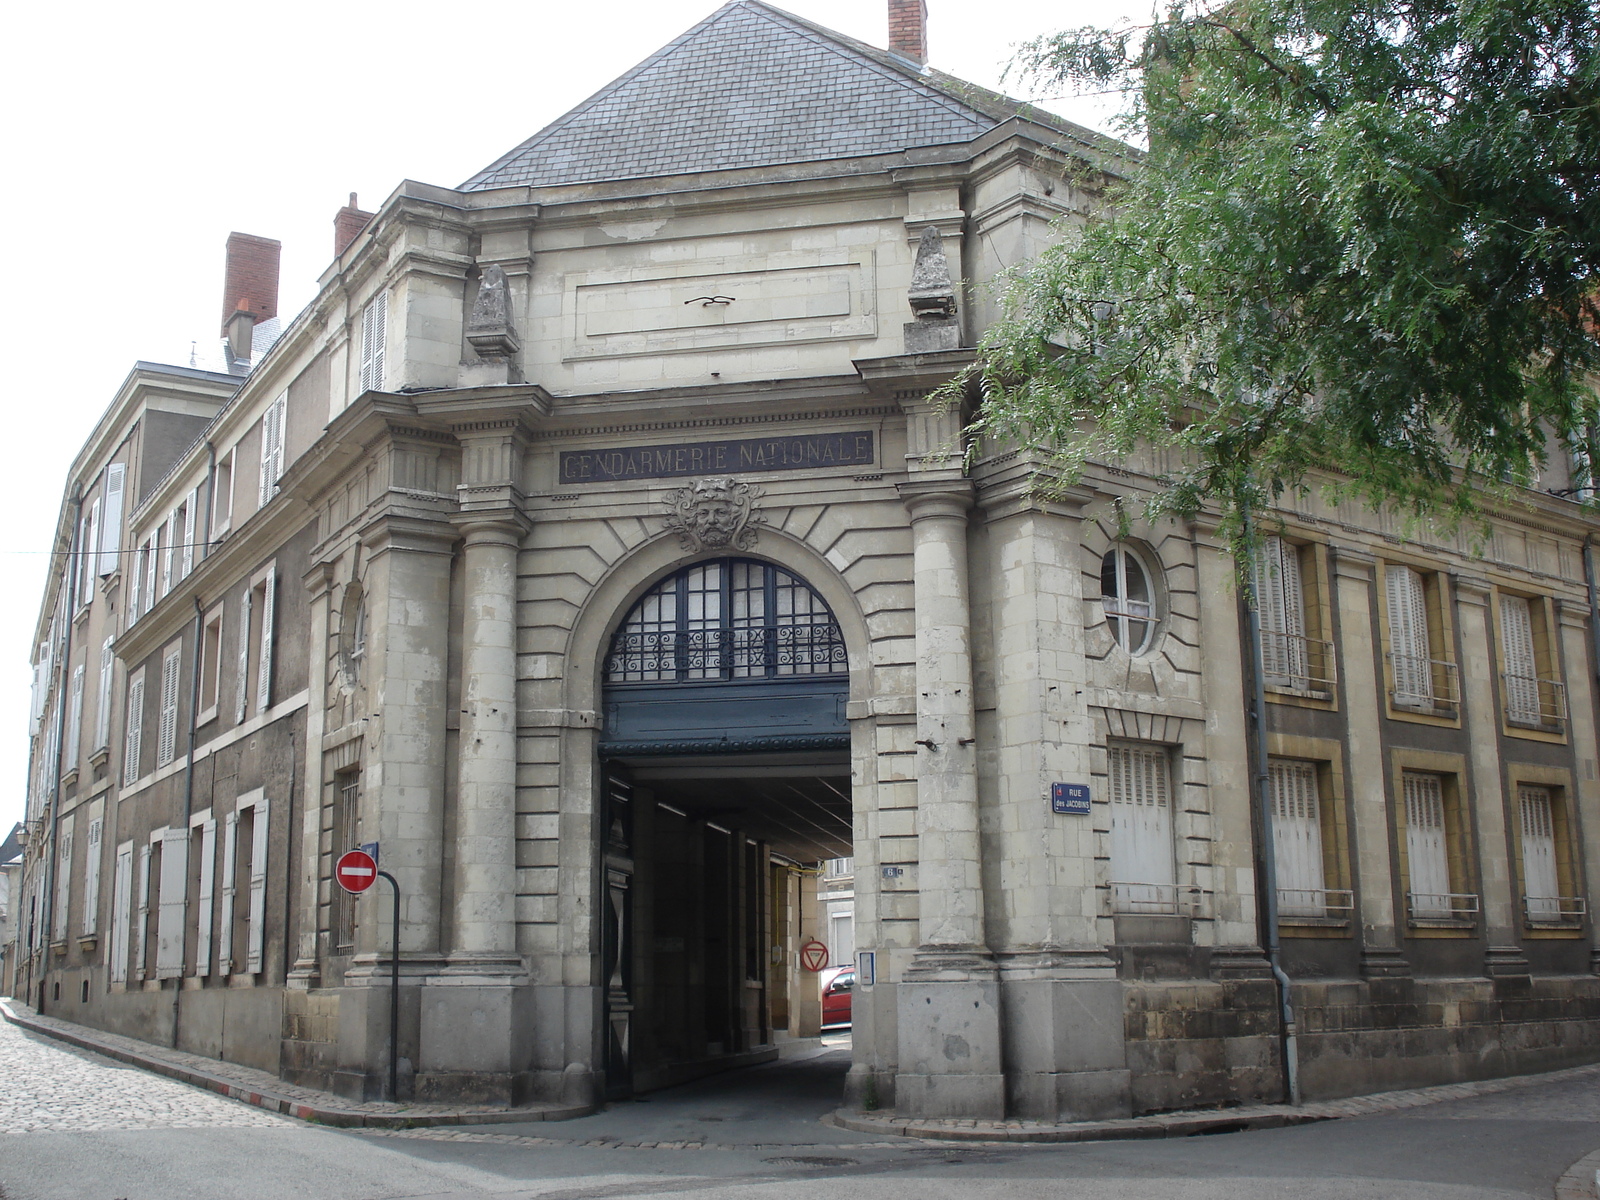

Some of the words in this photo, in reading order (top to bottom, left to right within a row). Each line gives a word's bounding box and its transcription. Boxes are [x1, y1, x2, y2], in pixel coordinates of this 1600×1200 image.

[564, 446, 727, 478] GENDARMERIE
[740, 436, 868, 467] NATIONALE
[1069, 789, 1082, 797] RUE
[1066, 800, 1090, 809] JACOBINS
